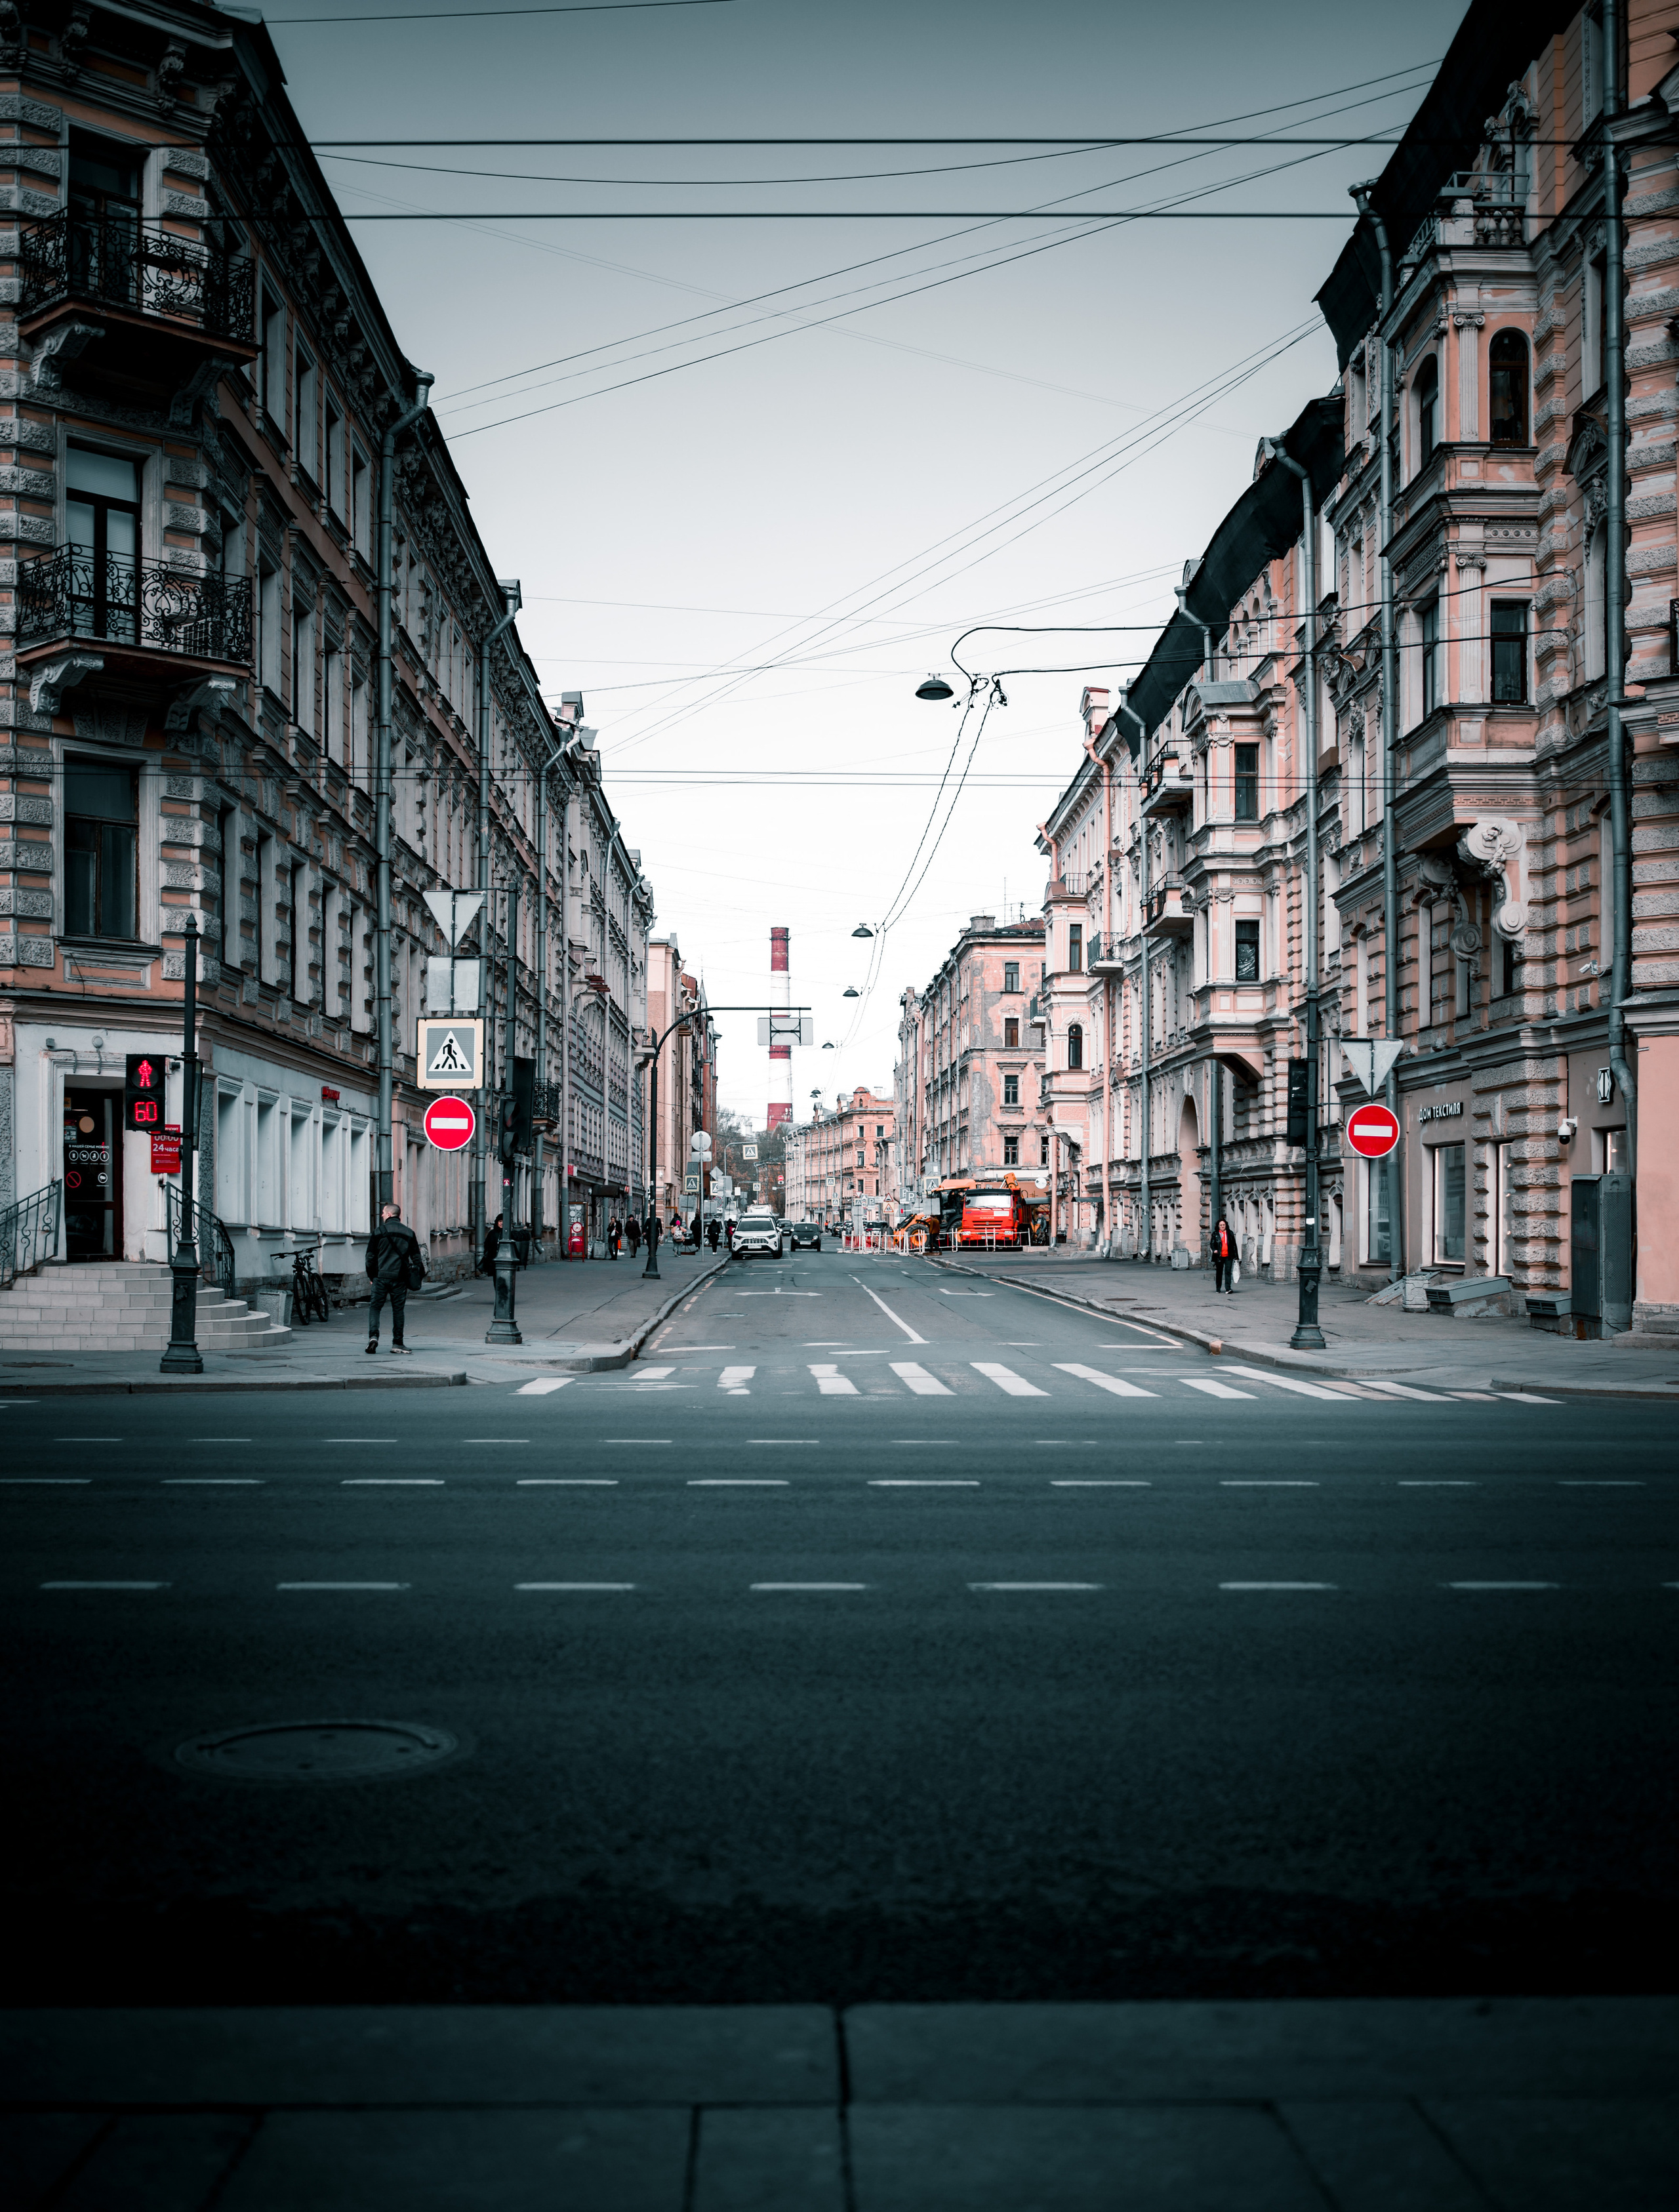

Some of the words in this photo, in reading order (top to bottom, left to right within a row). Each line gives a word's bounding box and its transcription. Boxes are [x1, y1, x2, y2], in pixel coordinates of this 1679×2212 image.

[135, 1101, 157, 1122] 60
[1419, 1108, 1431, 1122] ДОМ
[1432, 1102, 1461, 1118] ТЕКСТИЛЯ
[153, 1143, 165, 1152] 24
